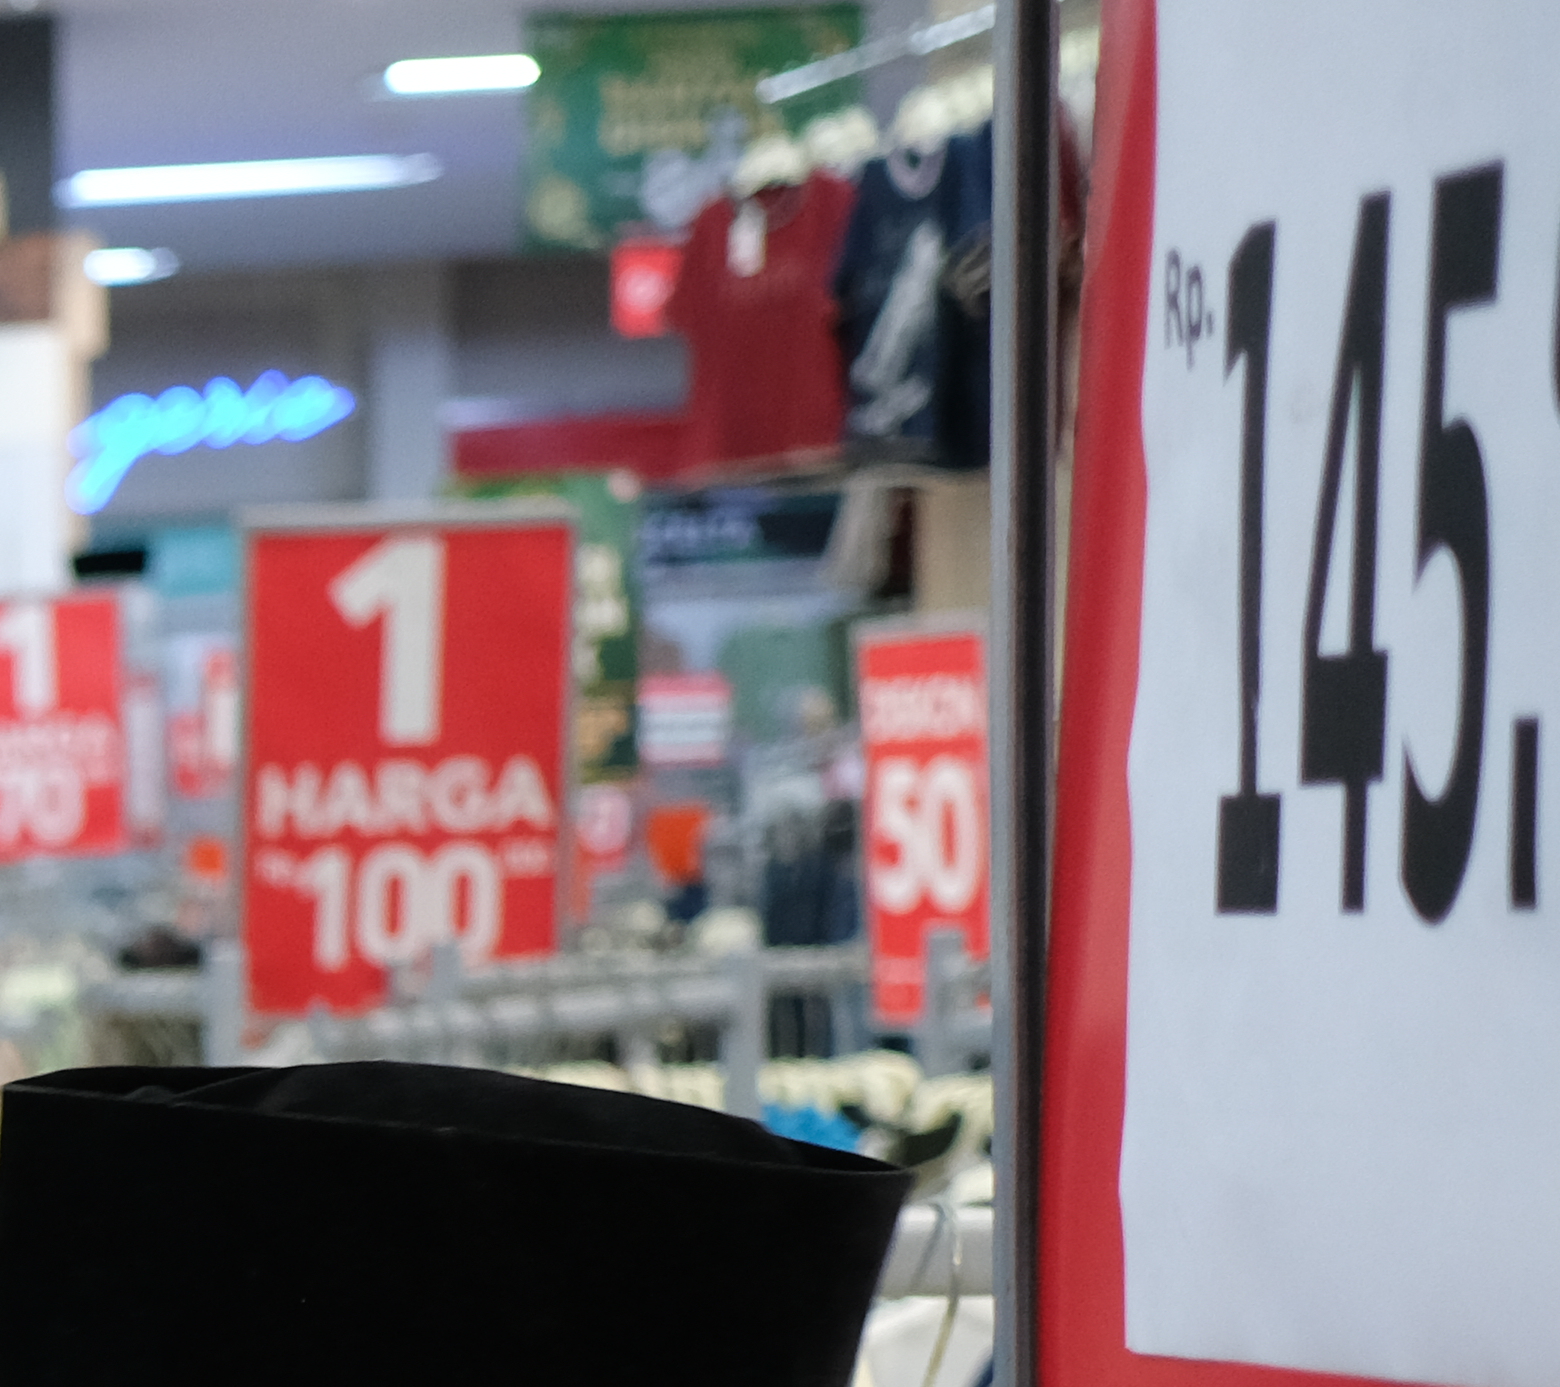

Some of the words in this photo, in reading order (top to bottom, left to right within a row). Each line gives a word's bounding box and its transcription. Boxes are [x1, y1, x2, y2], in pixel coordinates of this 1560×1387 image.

[1163, 246, 1214, 369] Rp.
[1216, 158, 1560, 928] 145.
[326, 532, 448, 748] 1
[255, 755, 555, 840] HARGA
[871, 755, 980, 915] 50
